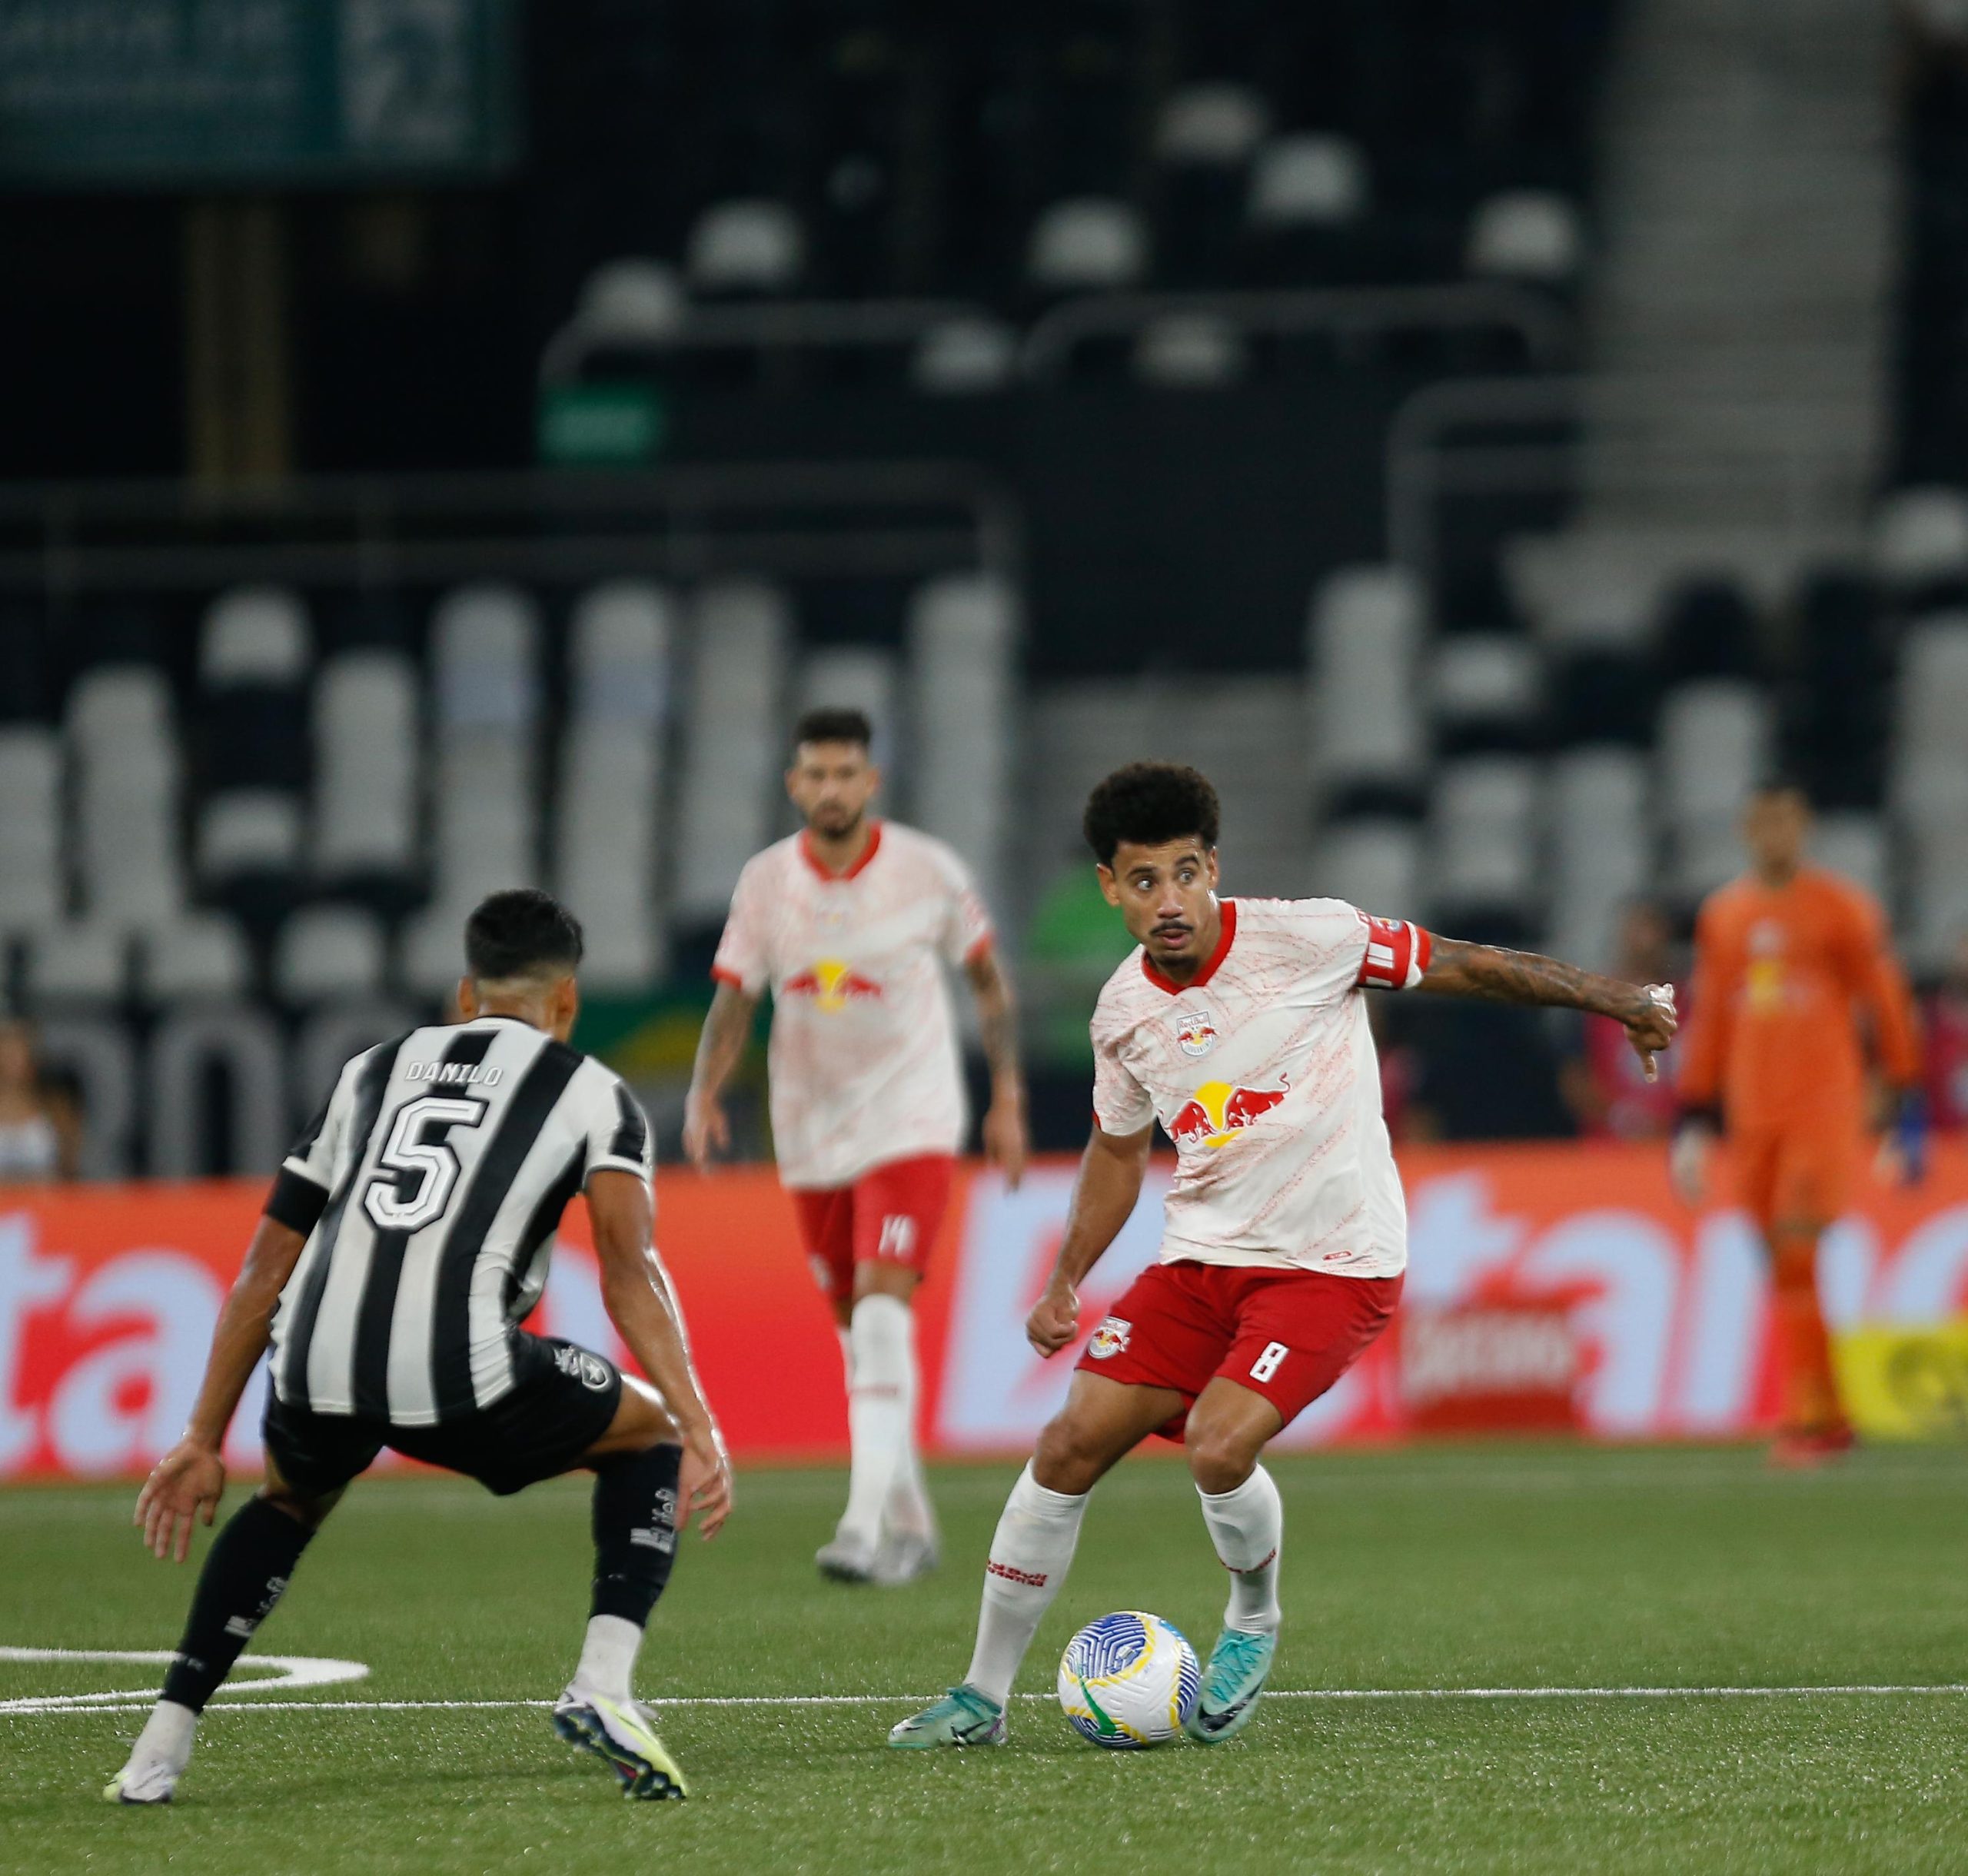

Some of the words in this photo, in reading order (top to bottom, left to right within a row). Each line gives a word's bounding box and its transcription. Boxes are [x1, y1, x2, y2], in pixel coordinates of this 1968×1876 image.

[406, 1060, 502, 1087] DANILO
[362, 1094, 490, 1232] 5
[1248, 1341, 1292, 1384] 8
